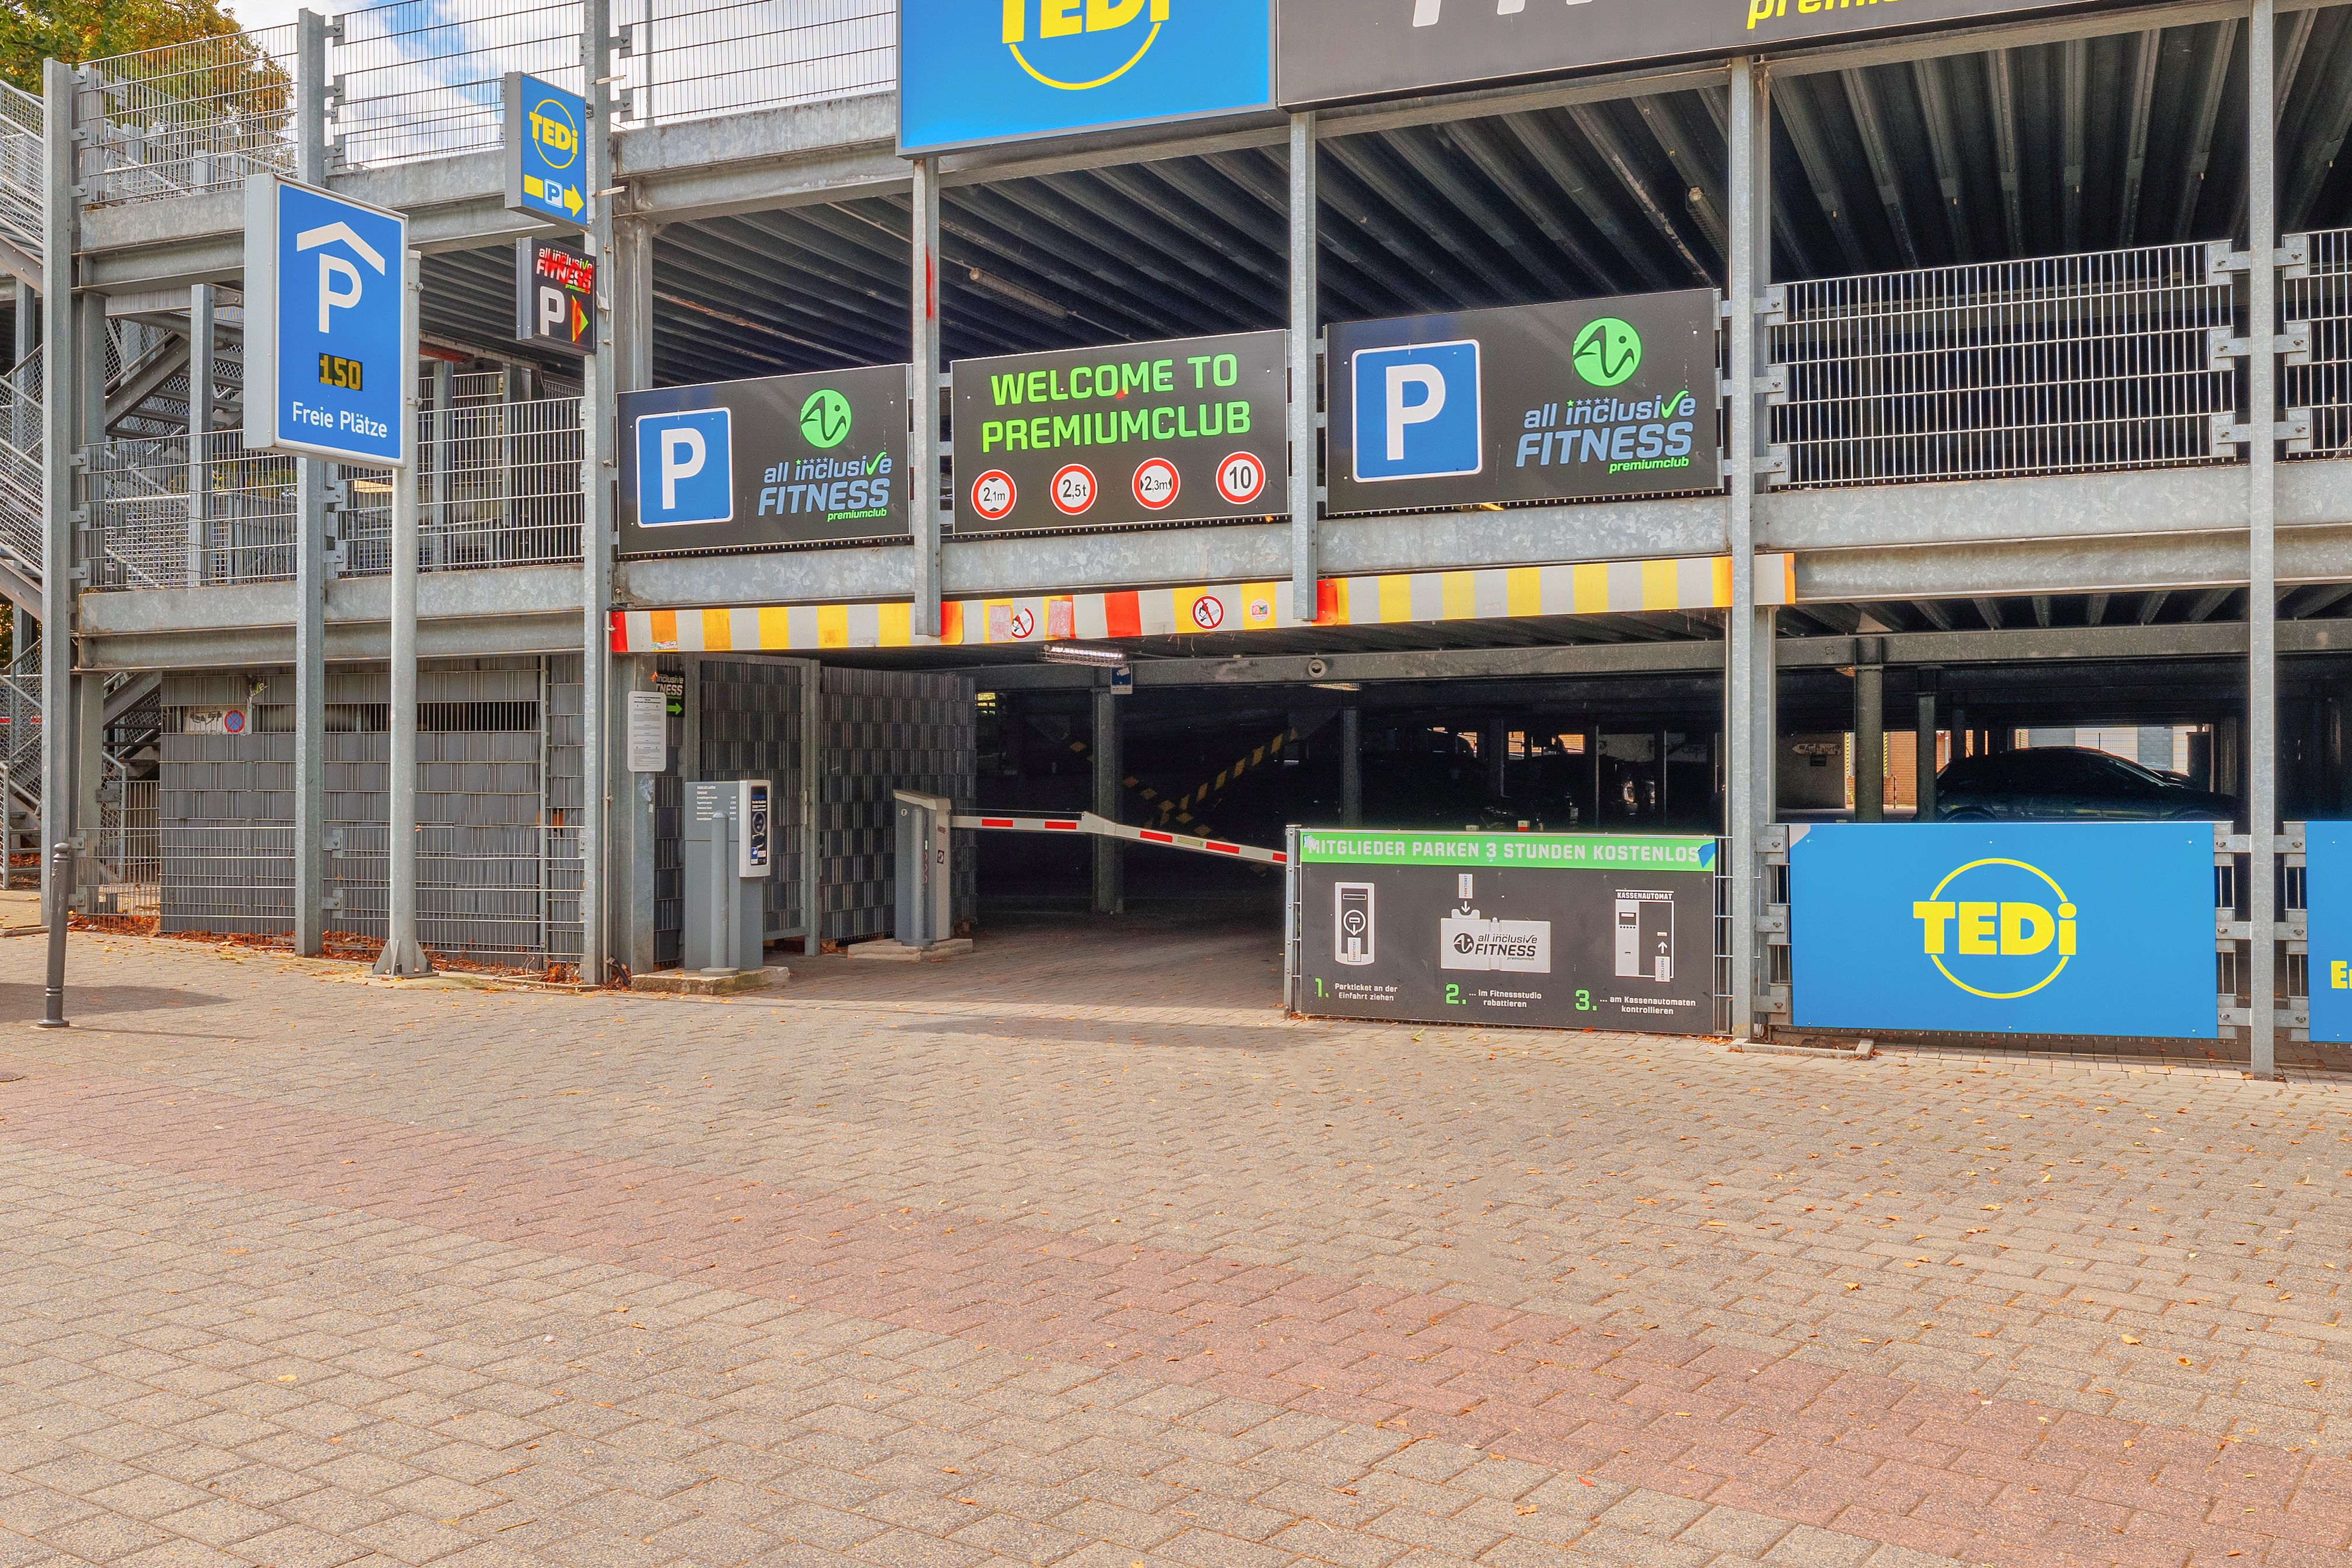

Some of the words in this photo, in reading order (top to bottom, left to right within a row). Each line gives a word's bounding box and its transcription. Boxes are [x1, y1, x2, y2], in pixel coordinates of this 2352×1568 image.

[529, 111, 578, 155] TEDi
[548, 183, 560, 201] P
[539, 247, 551, 259] all
[552, 249, 593, 271] inclusive
[536, 258, 592, 289] FITNESS
[319, 253, 362, 334] P
[540, 286, 565, 337] P
[320, 355, 361, 390] 150
[991, 358, 1174, 407] WELCOME
[1186, 353, 1238, 390] TO
[293, 401, 334, 428] Freie
[340, 410, 387, 438] Plätze
[1385, 363, 1446, 461] P
[1523, 403, 1558, 429] all
[1565, 390, 1696, 426] inclusive
[981, 400, 1252, 453] PREMIUMCLUB
[1516, 421, 1694, 467] FITNESS
[661, 428, 706, 510] P
[764, 461, 789, 484] all
[794, 451, 892, 481] inclusive
[1608, 456, 1690, 475] premiumclub
[1144, 475, 1168, 493] 2,3m
[1229, 466, 1252, 489] 10
[758, 477, 891, 516] FITNESS
[983, 487, 1006, 503] 2,1m
[827, 507, 888, 522] premiumclub
[1308, 839, 1405, 856] MITGLIEDER
[1412, 841, 1479, 858] PARKEN
[1486, 842, 1497, 858] 3
[1504, 843, 1585, 860] STUNDEN
[1594, 845, 1699, 862] KOSTENLOS
[1617, 892, 1672, 900] KASSENAUTOMAT
[1478, 934, 1489, 942] all
[1492, 934, 1538, 944] inclusive
[1913, 901, 2077, 956] TEDi
[1475, 943, 1536, 957] FITNESS
[1315, 978, 1329, 998] 1.
[1335, 983, 1371, 991] Parkticket
[1338, 992, 1367, 1000] Einfahrt
[1370, 993, 1394, 1001] ziehen
[1446, 984, 1466, 1005] 2.
[1490, 990, 1542, 999] Fitnessstudio
[1483, 999, 1527, 1007] rabattieren
[1575, 989, 1597, 1011] 3.
[1621, 1005, 1674, 1014] kontrollieren
[1624, 996, 1696, 1006] Kassenautomaten
